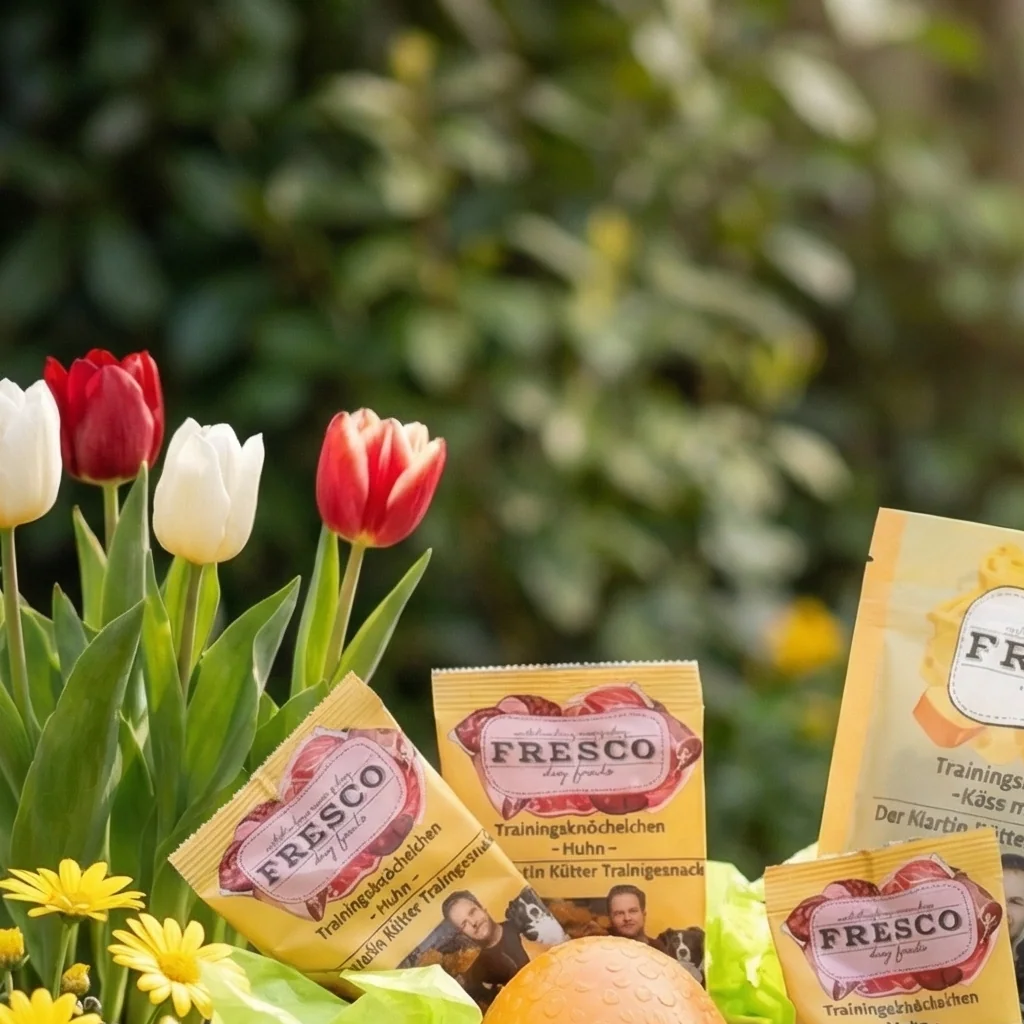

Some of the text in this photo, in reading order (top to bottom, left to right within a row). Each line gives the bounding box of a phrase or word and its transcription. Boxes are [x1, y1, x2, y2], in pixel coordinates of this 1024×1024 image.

[491, 738, 656, 764] FRESCO
[256, 764, 385, 887] FRESCO
[874, 804, 905, 824] Der
[562, 841, 605, 856] Huhn
[818, 908, 962, 950] FRESCO
